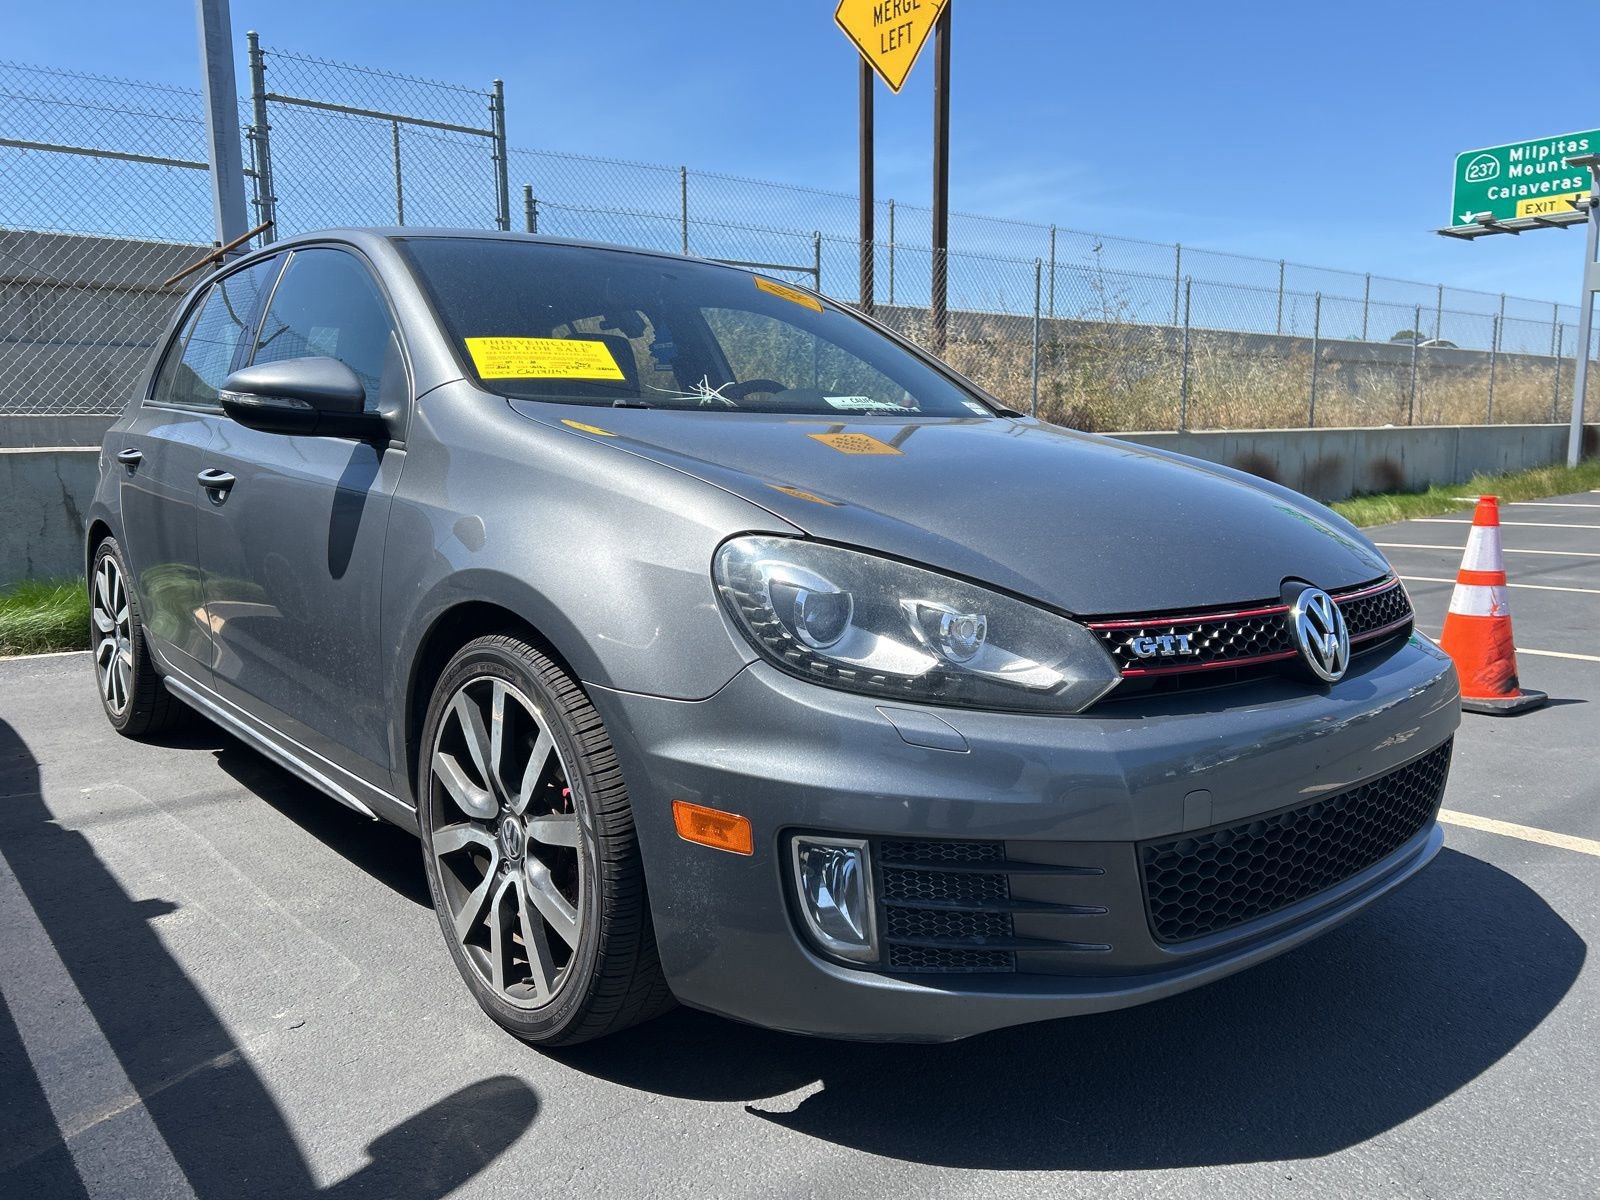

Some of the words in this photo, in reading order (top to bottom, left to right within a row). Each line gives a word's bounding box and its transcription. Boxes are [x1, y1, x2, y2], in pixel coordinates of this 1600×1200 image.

[880, 21, 913, 54] LEFT
[1509, 138, 1589, 162] Milpitas
[1469, 162, 1496, 179] 237
[1508, 156, 1577, 178] Mount
[1487, 176, 1583, 200] Calaveras
[1525, 200, 1557, 214] EXIT
[1131, 633, 1192, 658] GTI
